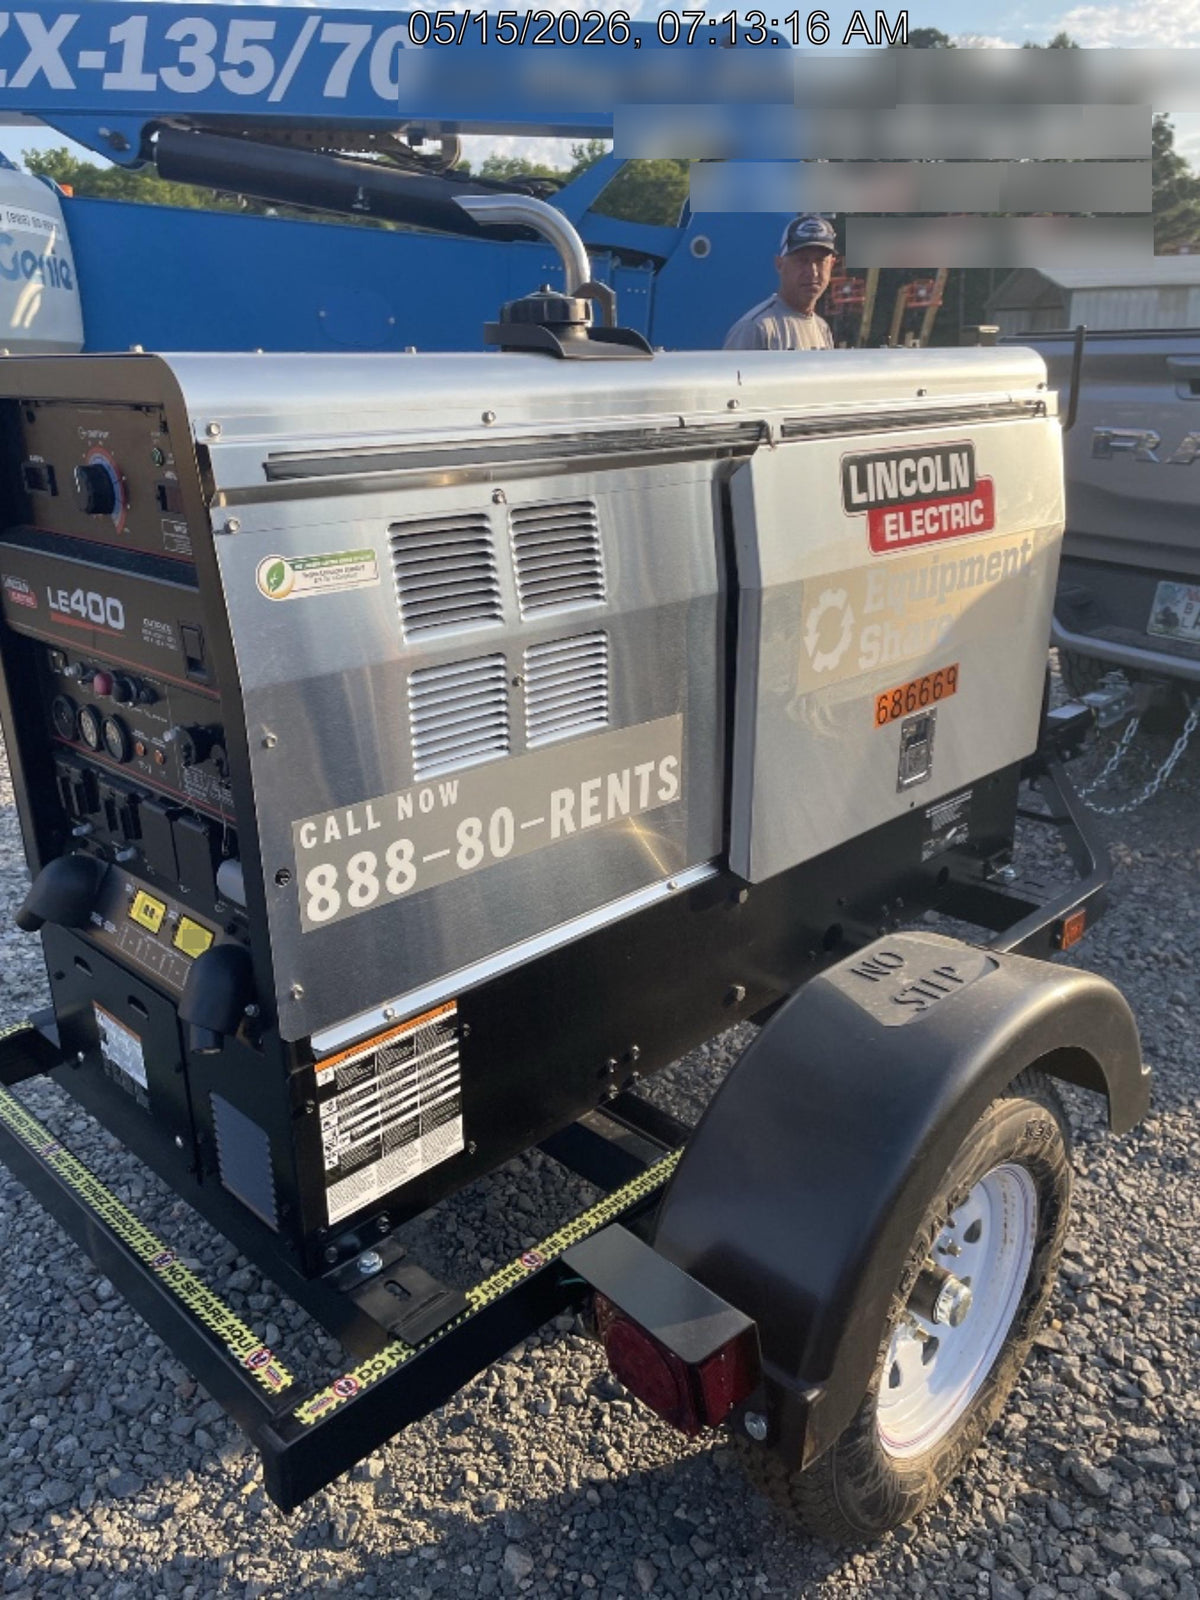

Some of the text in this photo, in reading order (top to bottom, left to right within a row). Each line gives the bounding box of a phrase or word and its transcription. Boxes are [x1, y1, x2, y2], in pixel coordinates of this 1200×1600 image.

[0, 12, 422, 101] X-135/70
[849, 451, 970, 504] LINCOLN
[884, 499, 984, 543] ELECTRIC
[863, 537, 1033, 617] Equipment
[47, 586, 125, 631] LE400
[876, 665, 957, 725] 686669
[300, 779, 460, 850] CALL NOW
[304, 754, 680, 922] 888-80-RENTS
[850, 951, 905, 982] NO
[64, 1163, 84, 1181] PAS
[562, 1219, 591, 1240] PAS
[165, 1264, 186, 1282] NO
[180, 1280, 201, 1297] SE
[194, 1295, 228, 1326] PARE
[357, 1359, 387, 1381] DO
[481, 1265, 525, 1295] HERE
